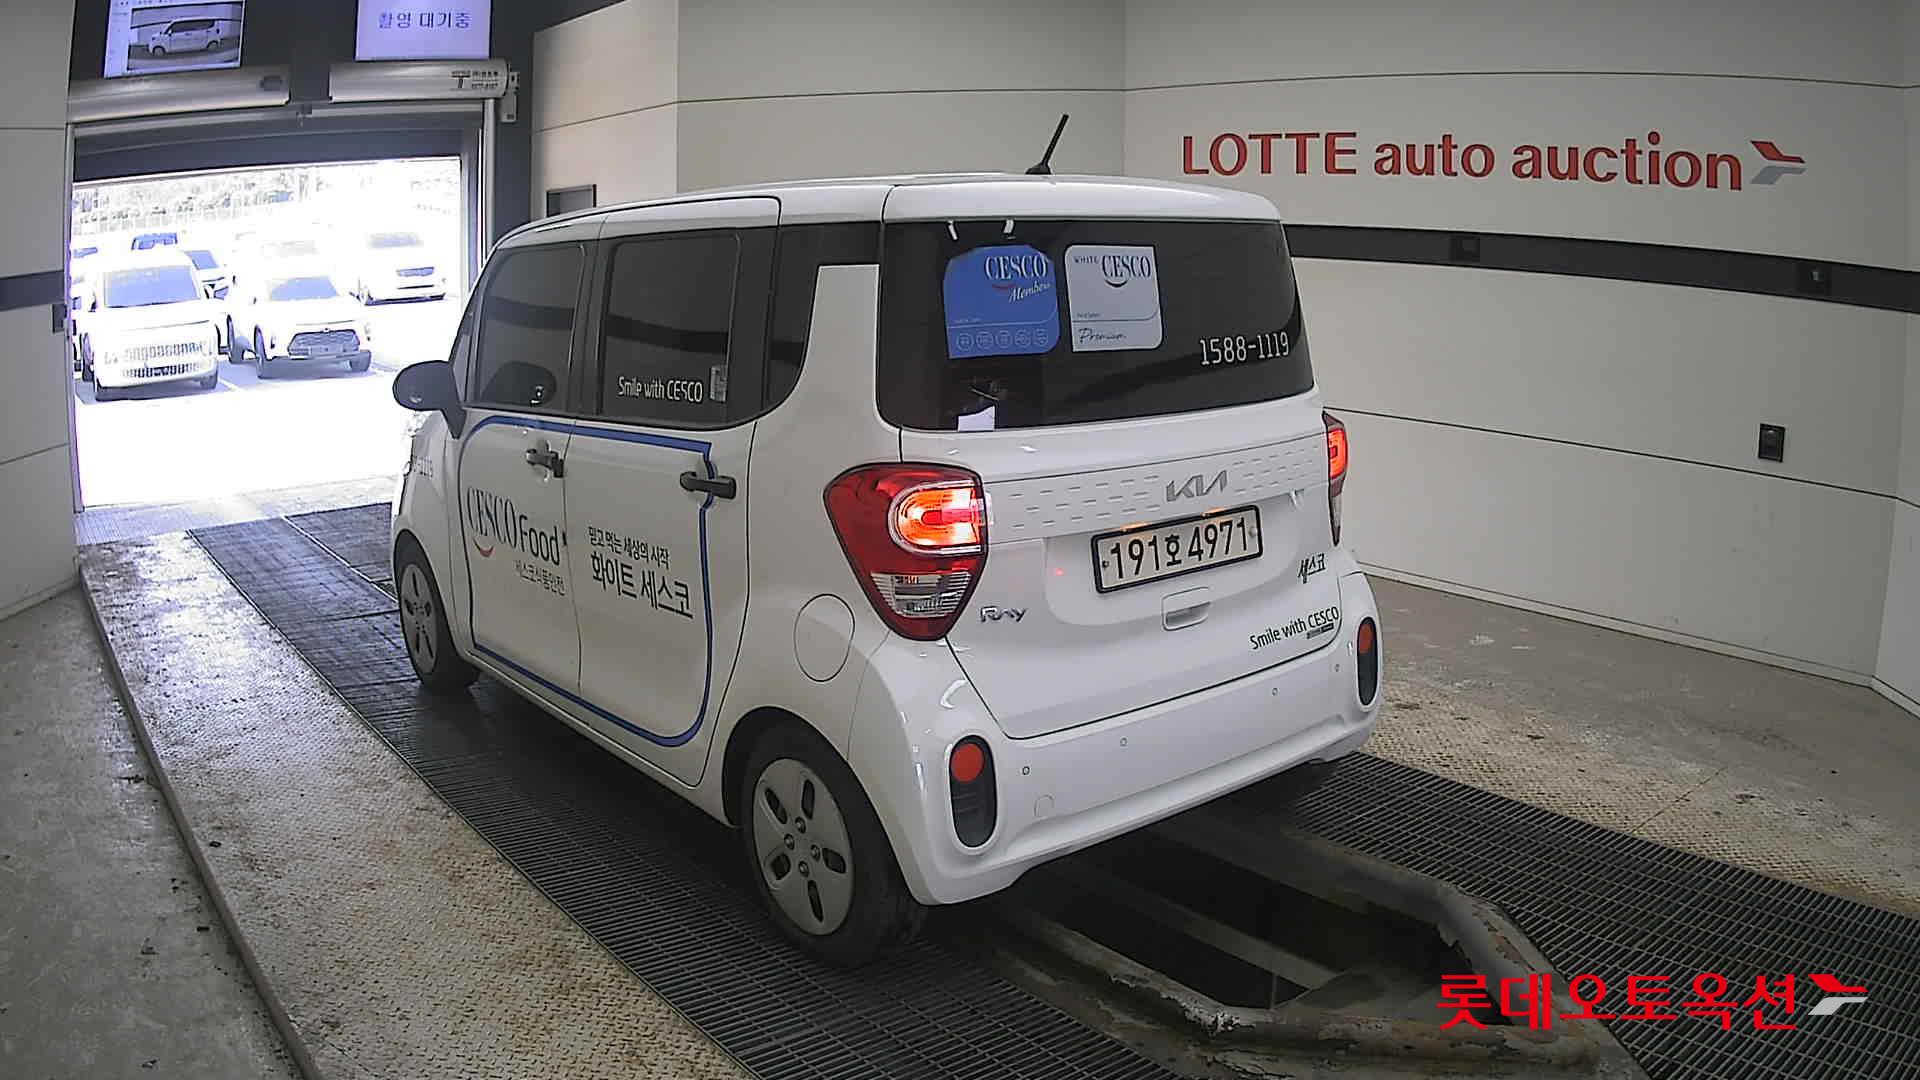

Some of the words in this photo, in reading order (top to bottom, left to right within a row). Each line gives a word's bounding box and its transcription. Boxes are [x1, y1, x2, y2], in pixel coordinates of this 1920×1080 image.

[418, 11, 473, 29] 대기중
[1183, 131, 1358, 177] LOTTE
[1374, 133, 1496, 179] auto
[1512, 131, 1743, 191] auction
[985, 255, 1048, 279] CESCO
[1102, 255, 1151, 278] CESCO
[1199, 331, 1289, 365] 1588-1119
[618, 376, 642, 397] Smile
[644, 377, 665, 399] with
[667, 380, 703, 402] CESCO
[466, 487, 517, 549] CESCO
[519, 514, 560, 566] Food
[624, 536, 649, 563] 세상의
[651, 545, 669, 570] 시작
[591, 551, 637, 599] 화이트
[640, 570, 693, 619] 세스코
[1250, 627, 1281, 650] Smile
[1281, 617, 1307, 638] with
[1307, 606, 1339, 628] CESCO
